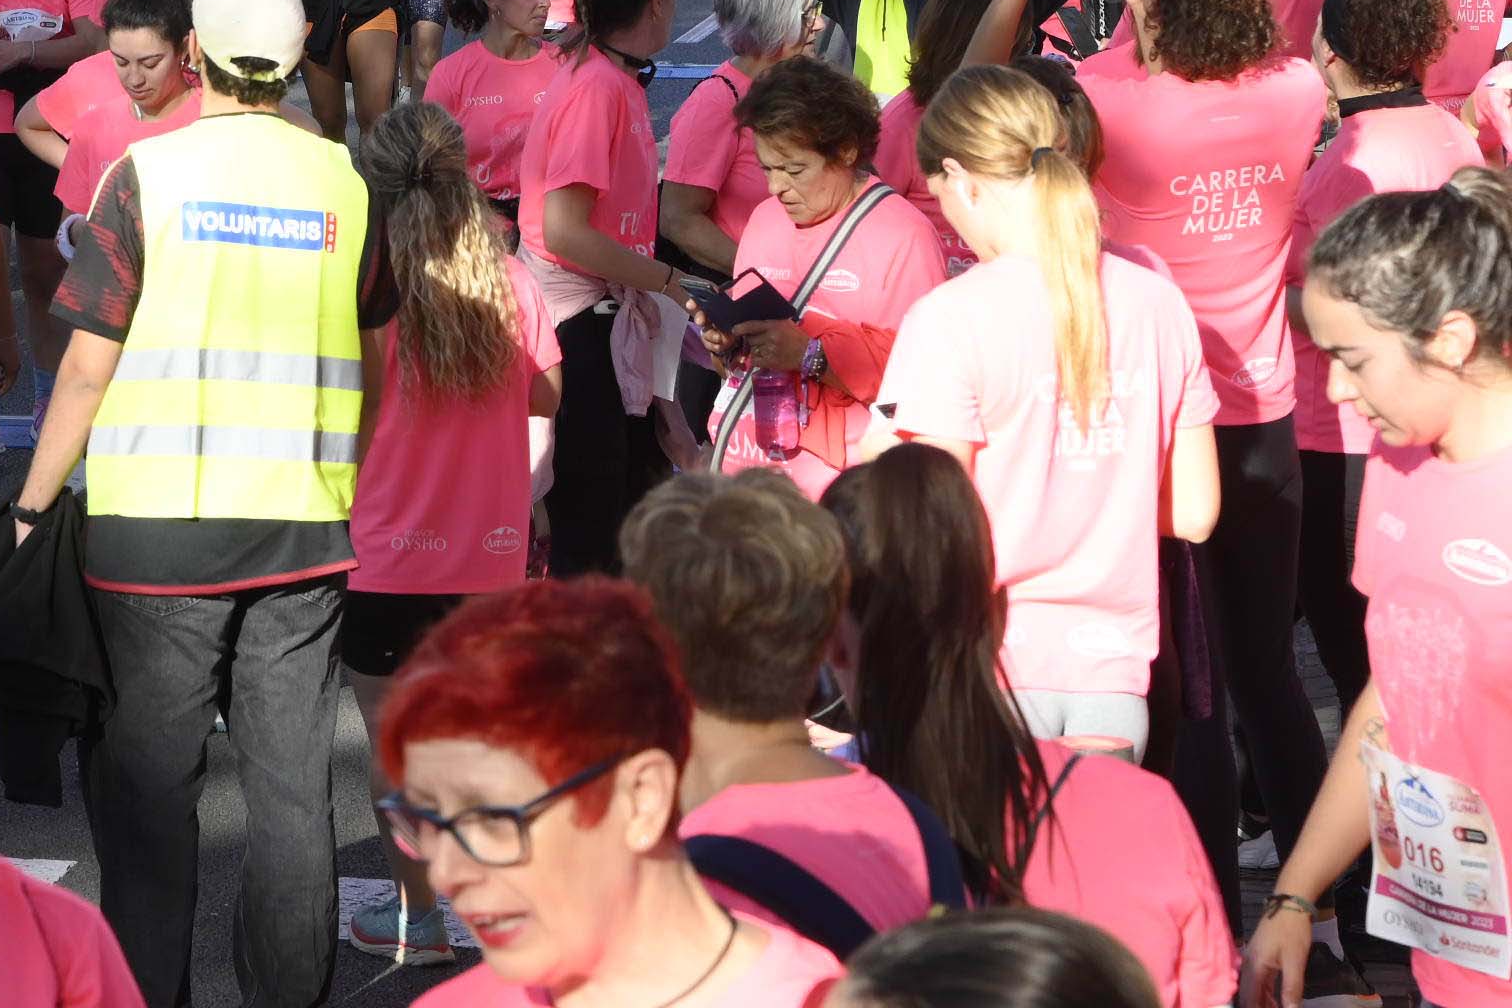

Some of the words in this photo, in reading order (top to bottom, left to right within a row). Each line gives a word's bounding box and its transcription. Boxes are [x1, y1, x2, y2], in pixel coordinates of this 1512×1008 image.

[1455, 7, 1496, 25] MUJER
[1169, 162, 1286, 197] CARRERA
[1191, 192, 1225, 216] DE
[1231, 186, 1262, 210] LA
[186, 209, 322, 243] VOLUNTARIS
[1180, 206, 1264, 236] MUJER
[390, 536, 447, 552] OYSHO
[1403, 835, 1445, 874] 016
